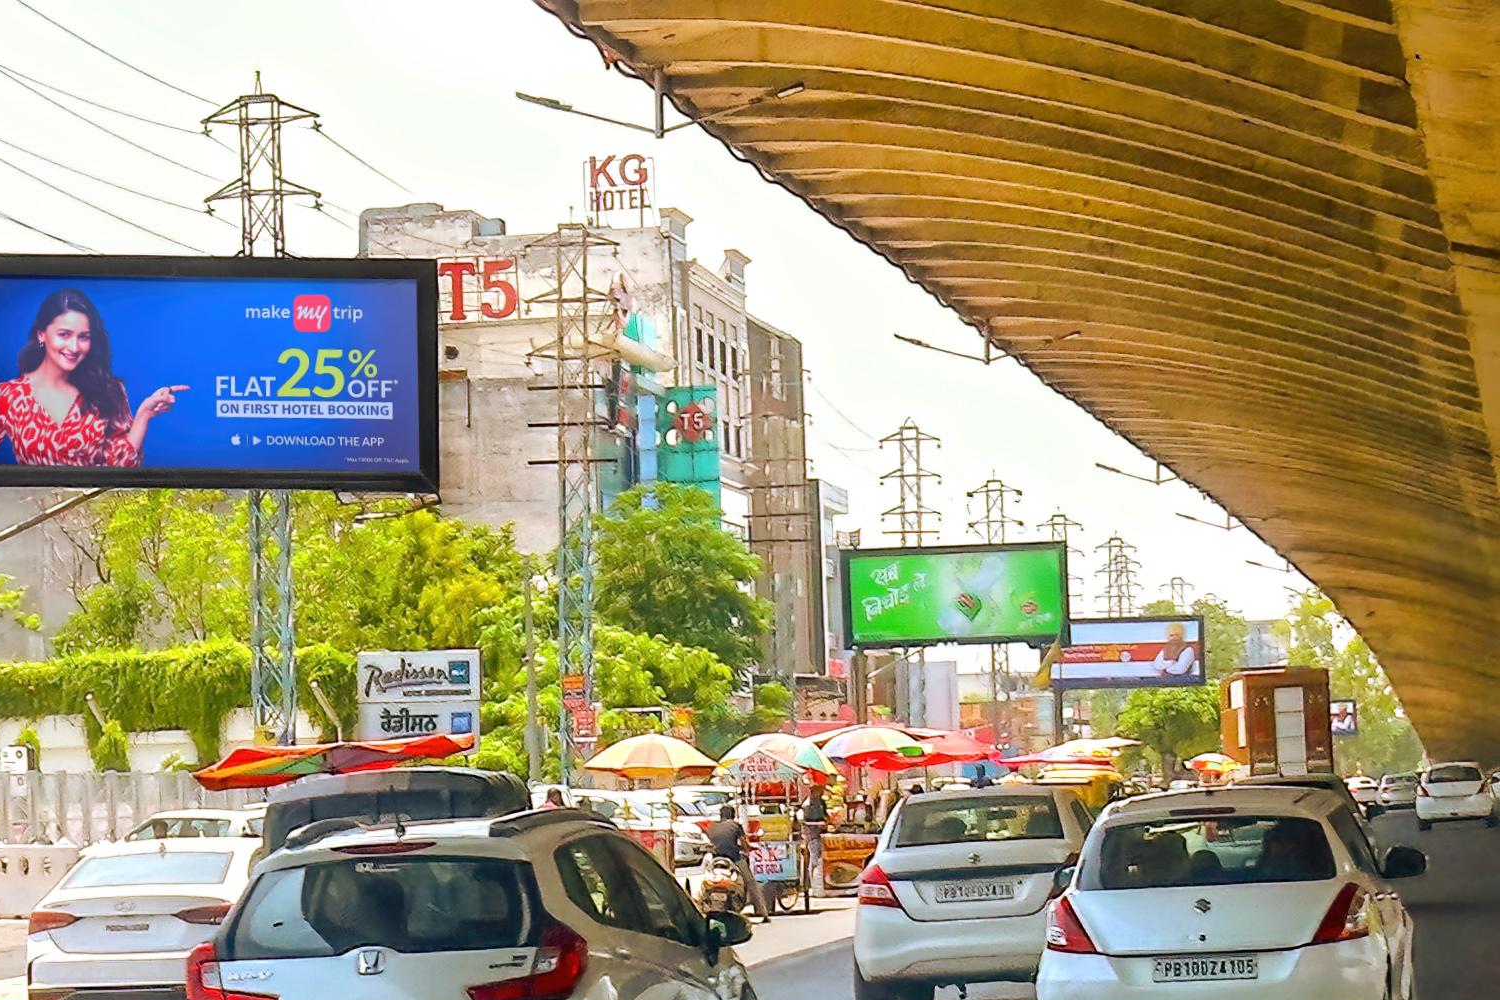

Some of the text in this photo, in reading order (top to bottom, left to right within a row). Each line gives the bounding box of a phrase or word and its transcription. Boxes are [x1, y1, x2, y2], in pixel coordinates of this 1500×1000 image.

[589, 154, 649, 188] KG
[589, 188, 652, 212] HOTEL
[438, 259, 518, 321] T5
[245, 305, 291, 319] make
[332, 305, 364, 323] trip
[215, 376, 276, 397] FLAT
[219, 403, 390, 417] ON FIRST HOTEL BOOKING
[680, 412, 704, 430] T5
[266, 435, 385, 448] DOWNLOAD THE APP
